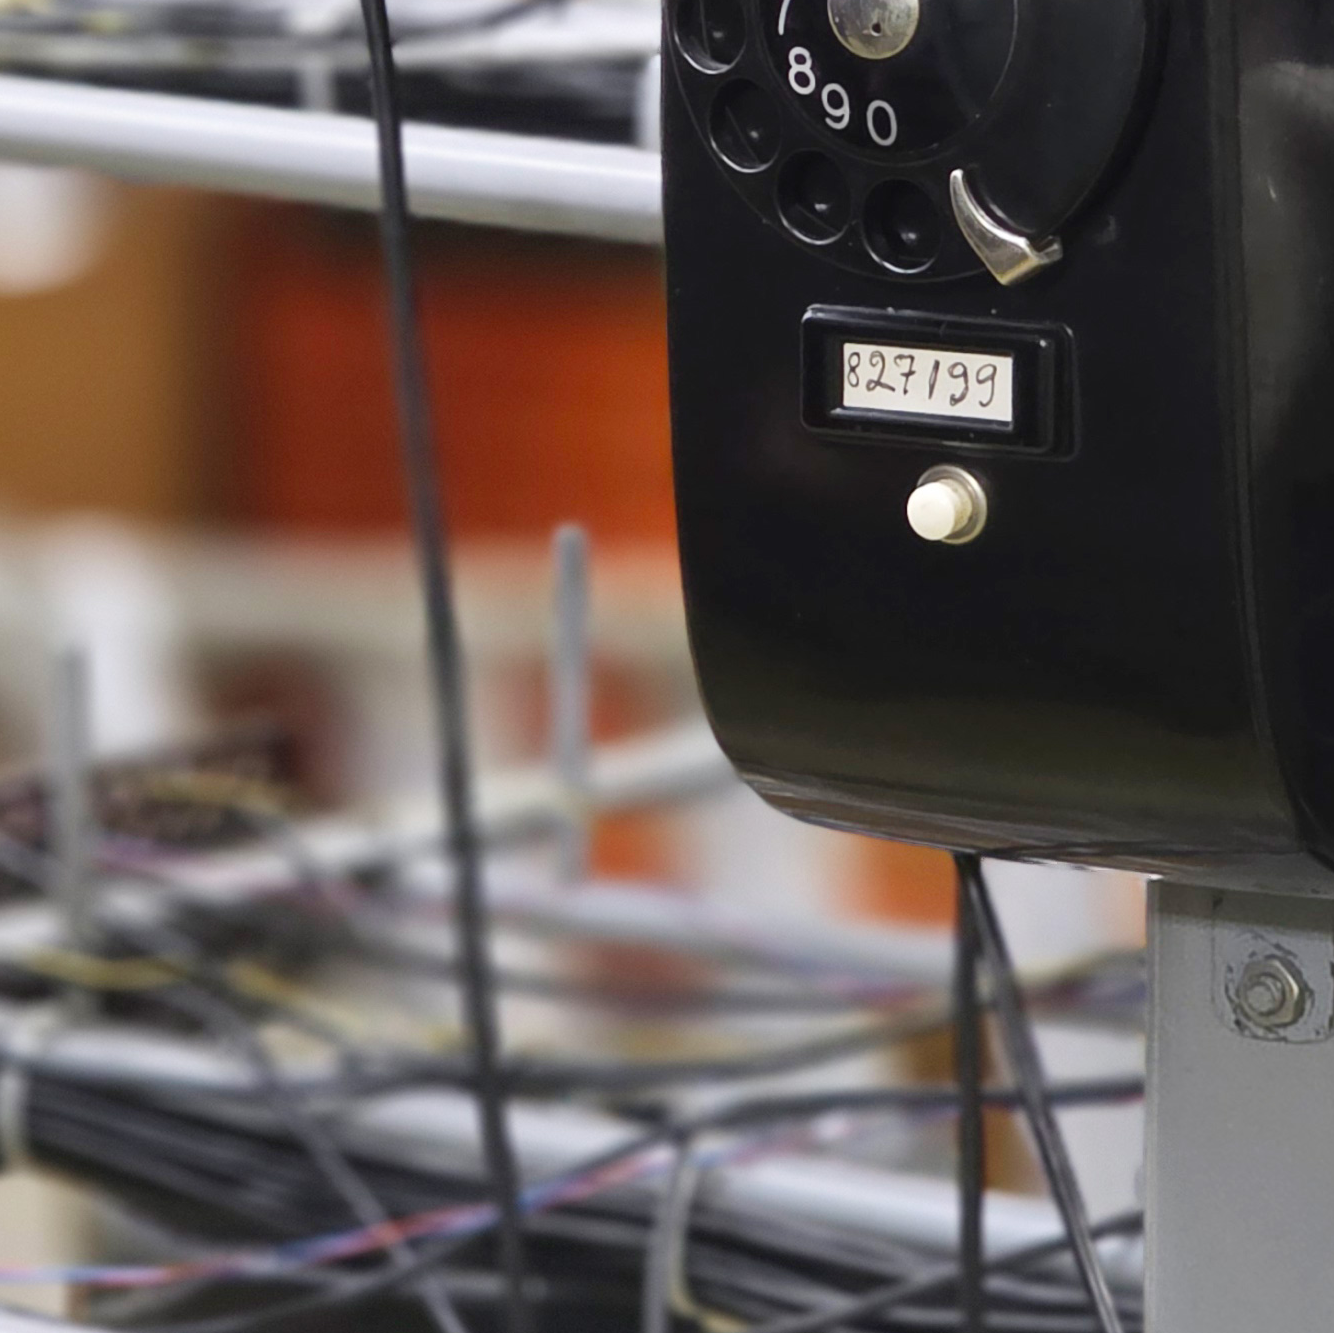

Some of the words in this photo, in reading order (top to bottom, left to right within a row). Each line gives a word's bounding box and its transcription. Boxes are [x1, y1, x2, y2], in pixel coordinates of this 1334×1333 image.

[788, 46, 816, 95] 8
[821, 82, 851, 130] 9
[866, 99, 898, 147] 0
[846, 350, 998, 408] 827199
